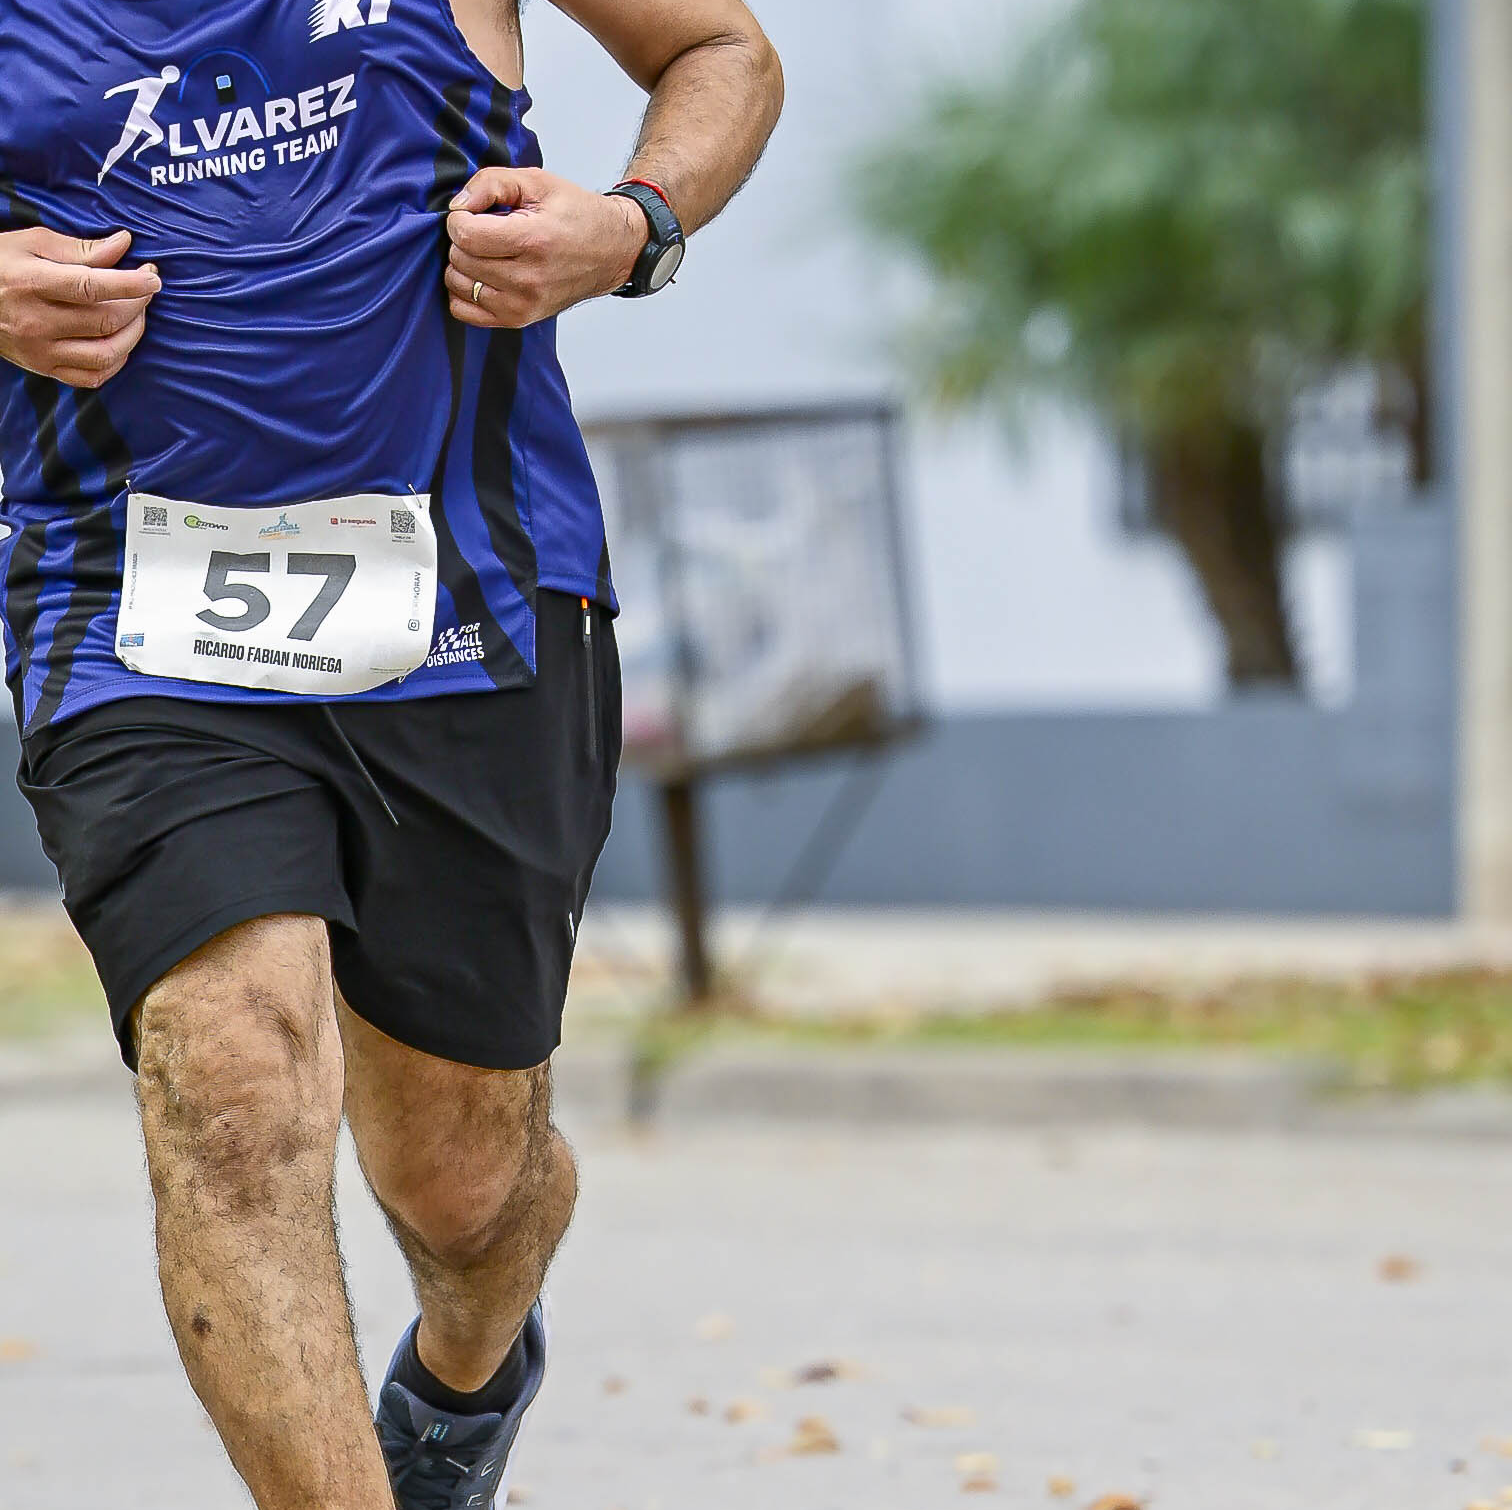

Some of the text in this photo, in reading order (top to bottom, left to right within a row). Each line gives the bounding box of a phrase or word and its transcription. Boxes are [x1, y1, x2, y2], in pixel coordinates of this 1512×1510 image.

[150, 125, 339, 187] RUNNING TEAM
[195, 550, 357, 642] 57
[459, 622, 481, 635] FOR
[460, 632, 482, 648] ALL
[193, 639, 343, 674] RICARDO FABIAN NORIEGA
[426, 647, 485, 668] DISTANCES
